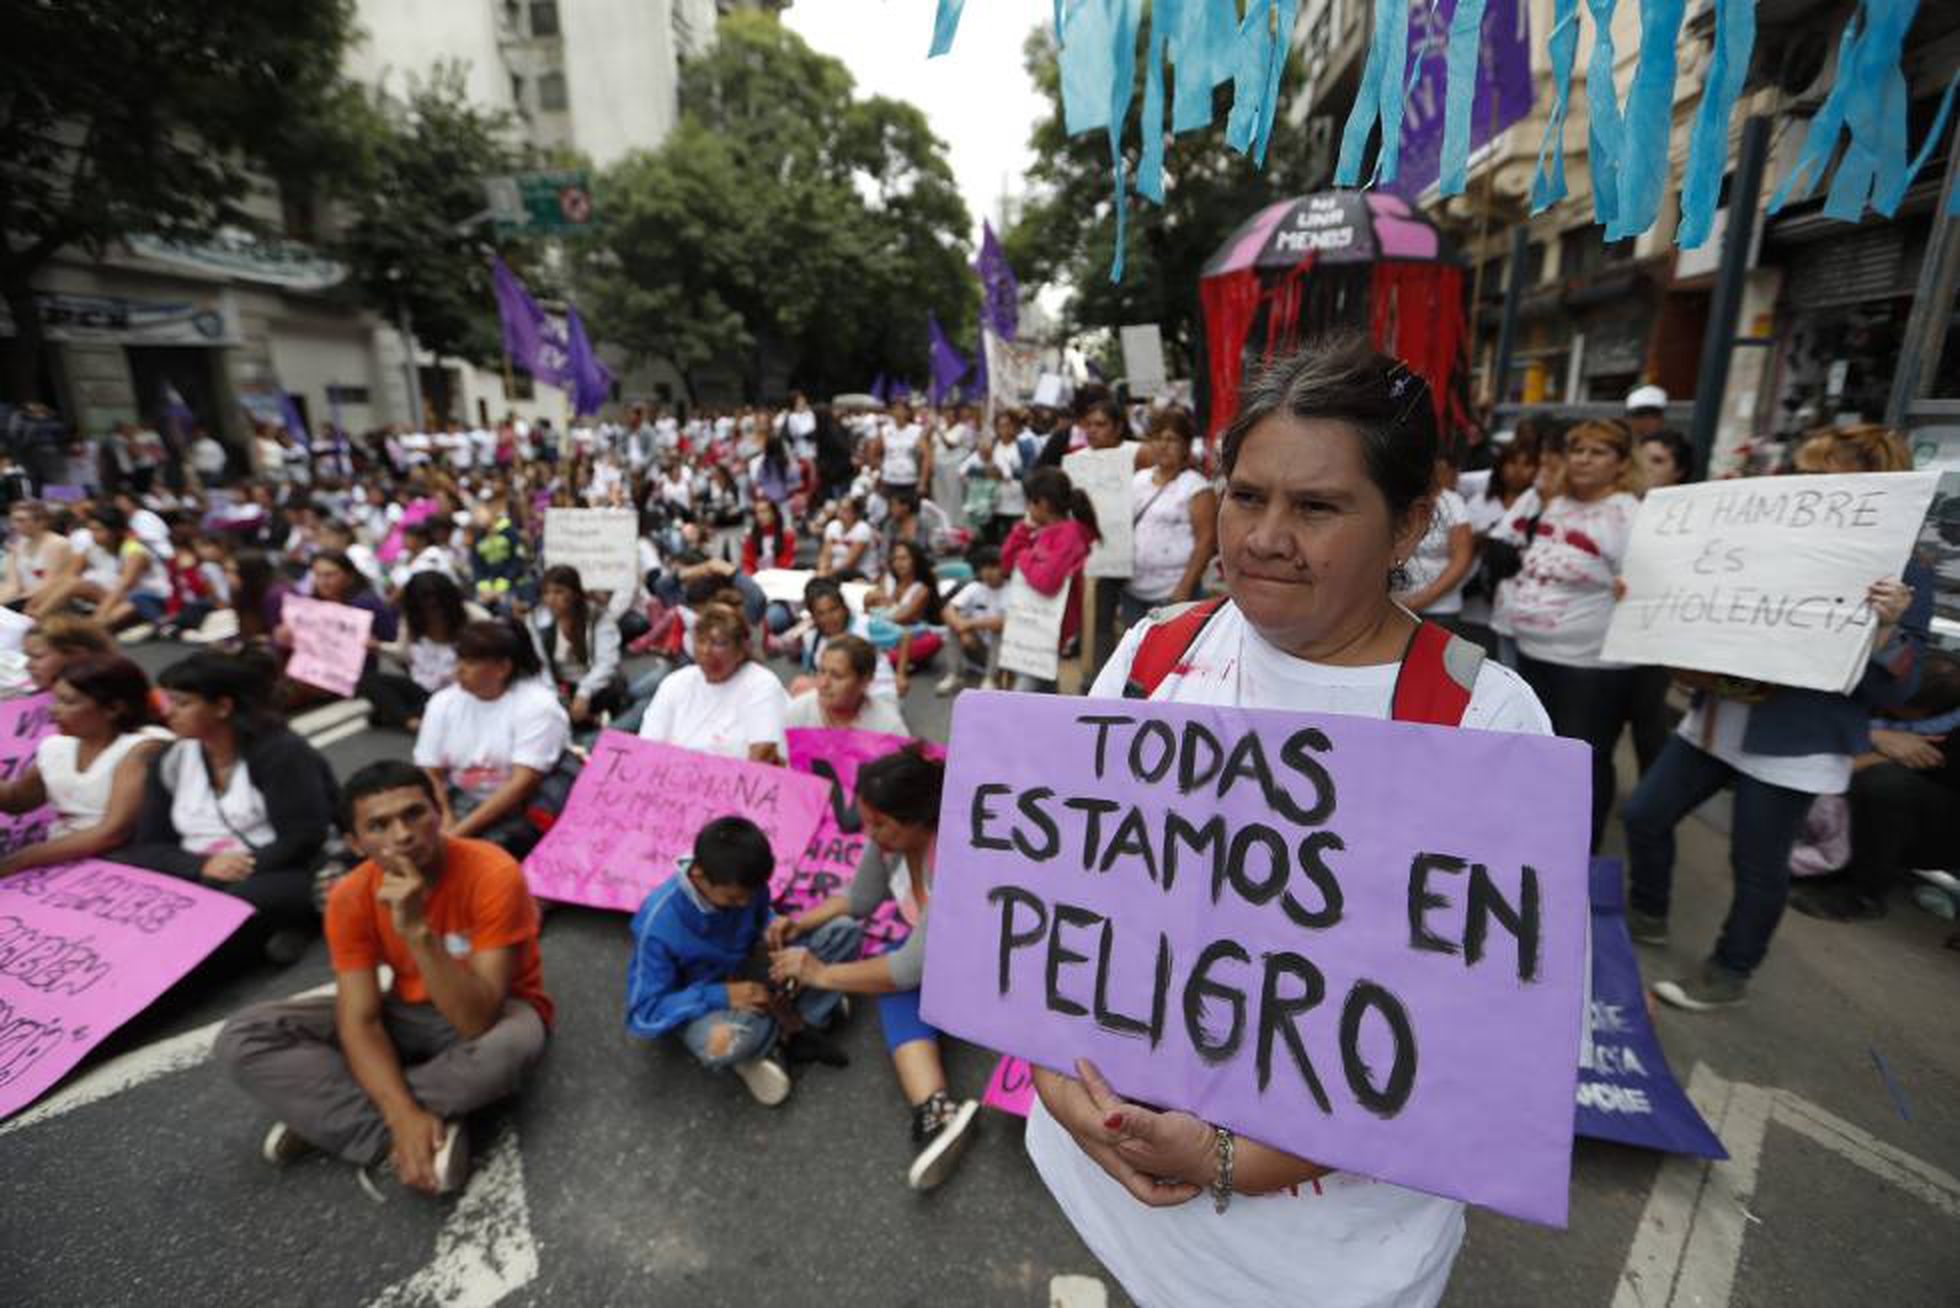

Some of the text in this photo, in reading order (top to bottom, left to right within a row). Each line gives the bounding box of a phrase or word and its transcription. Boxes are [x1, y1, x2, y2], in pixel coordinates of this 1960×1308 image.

[1276, 226, 1353, 250] MENOS
[1657, 490, 1888, 536] EL HAMBRE
[1693, 538, 1746, 575] ES
[1077, 714, 1336, 827] TODAS
[969, 782, 1345, 929] ESTAMOS
[1408, 851, 1542, 984] EN
[987, 885, 1418, 1120] PELIGRO
